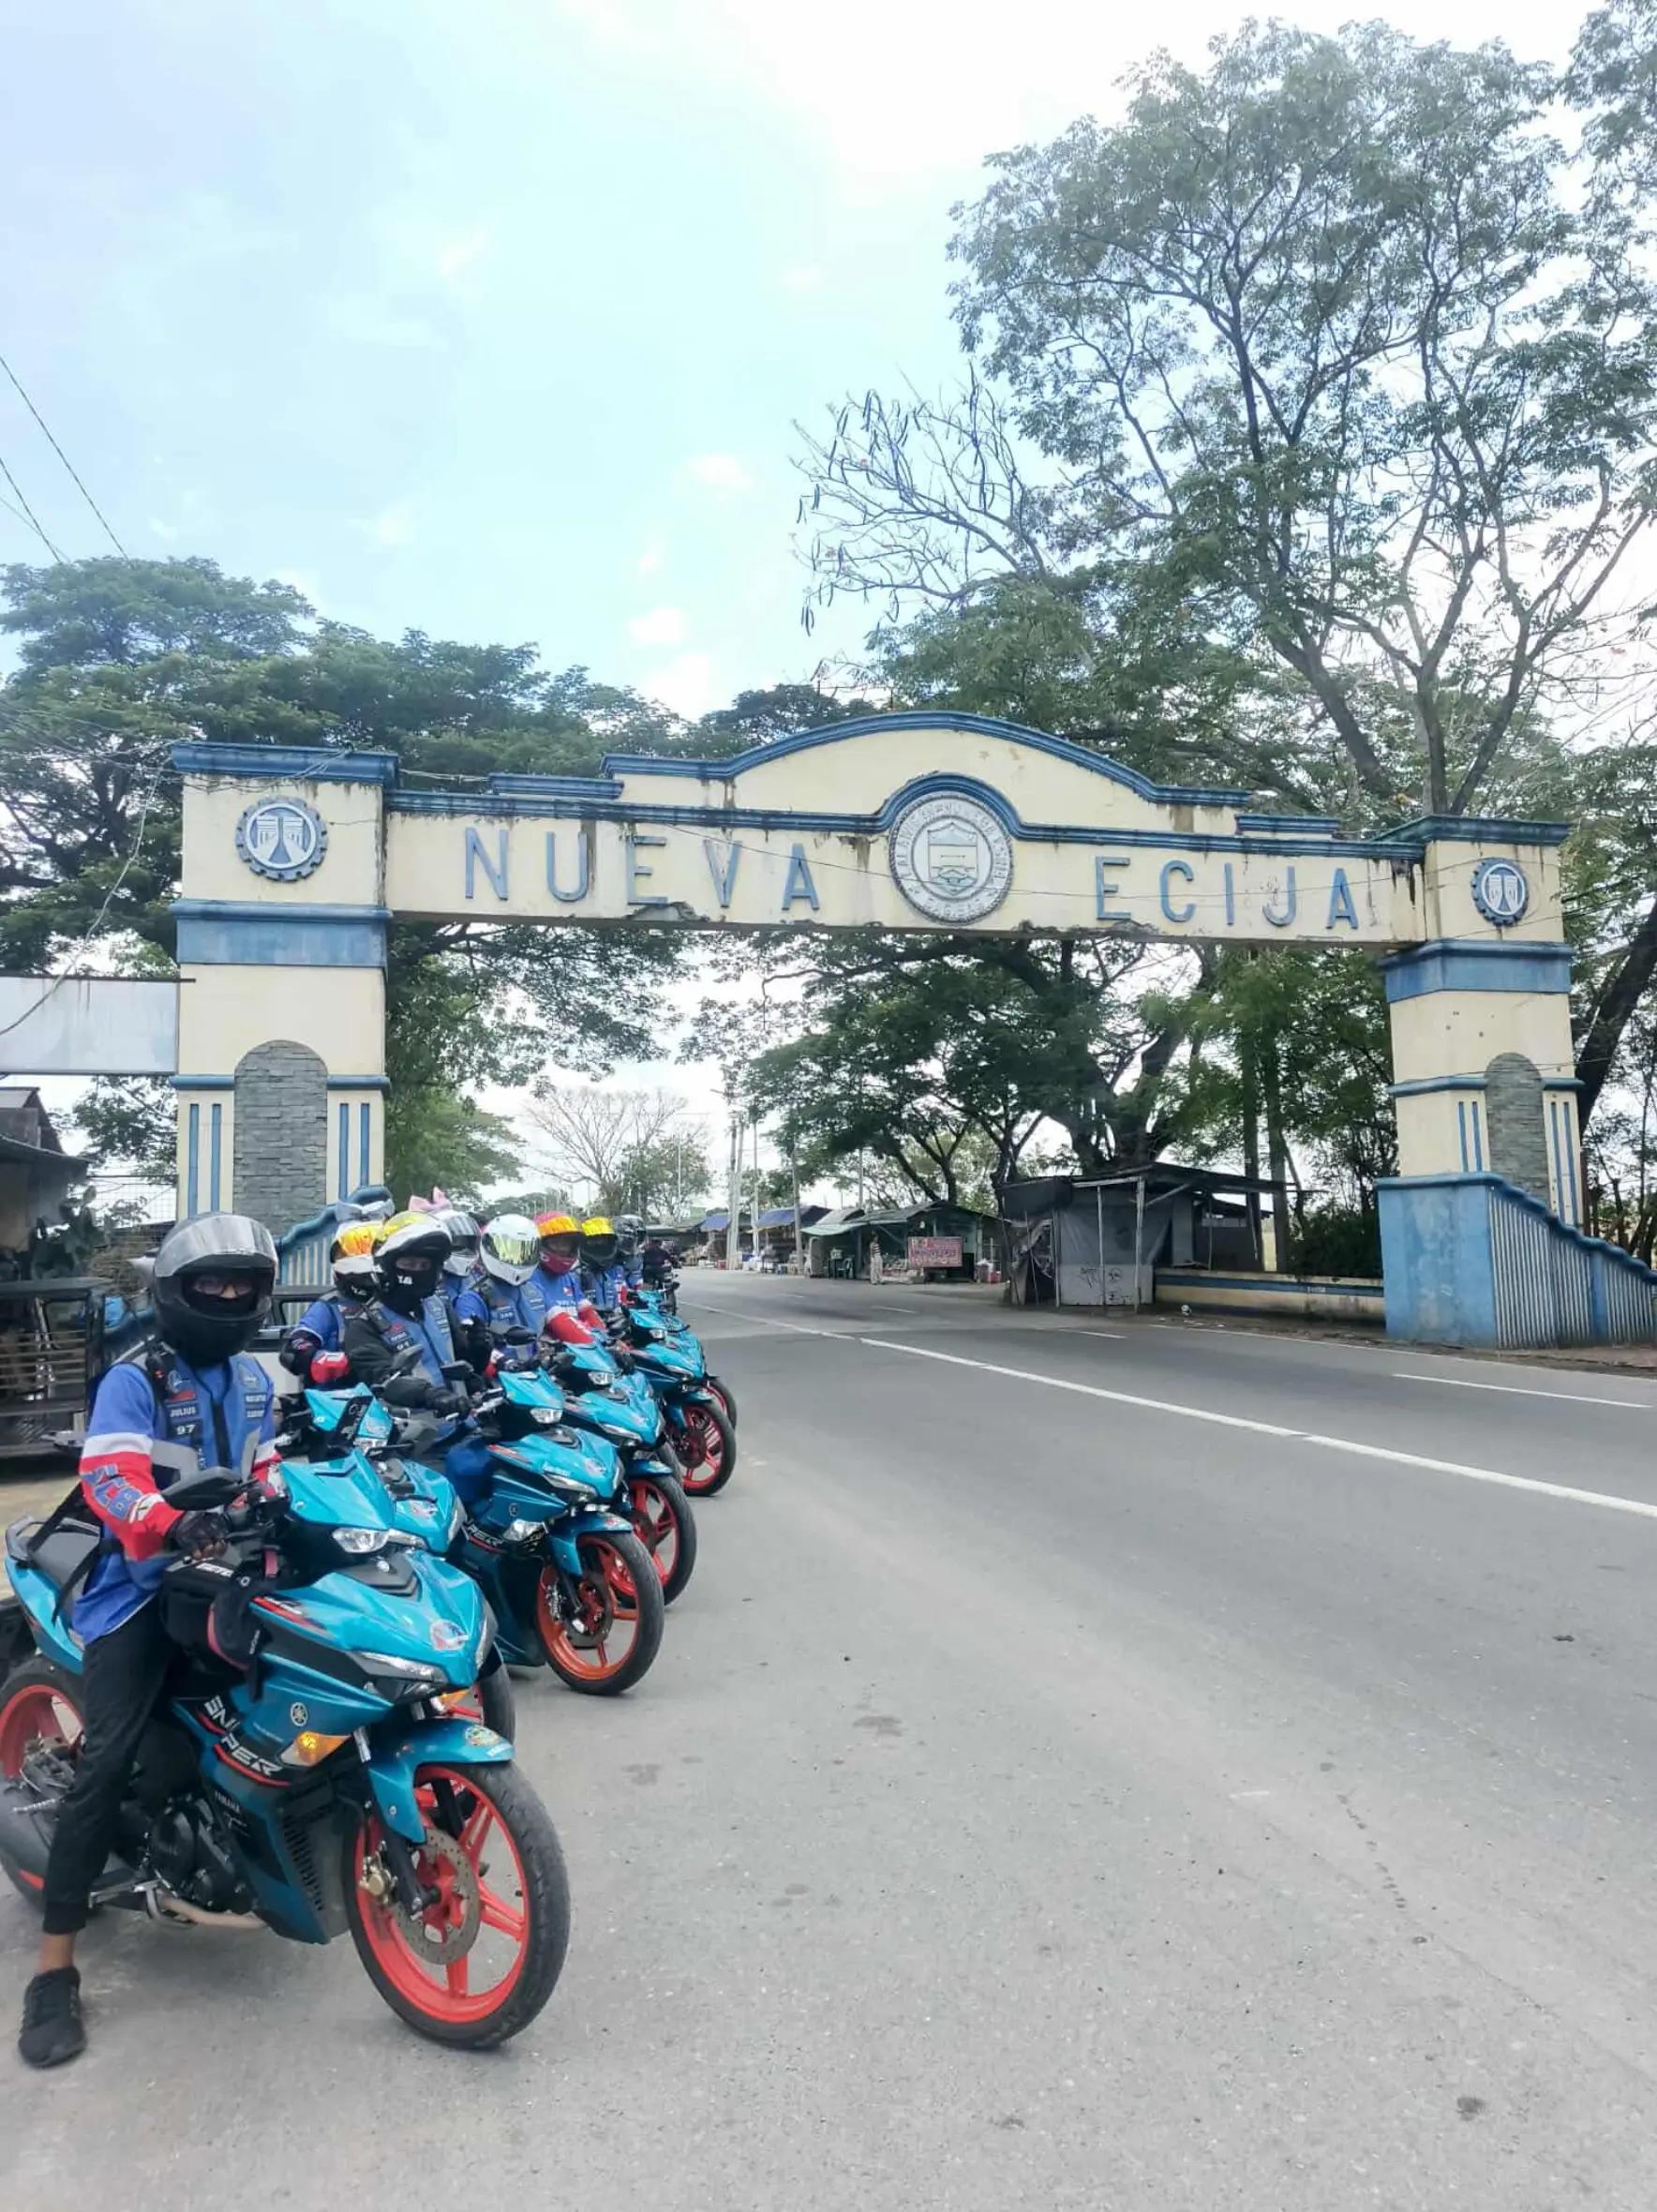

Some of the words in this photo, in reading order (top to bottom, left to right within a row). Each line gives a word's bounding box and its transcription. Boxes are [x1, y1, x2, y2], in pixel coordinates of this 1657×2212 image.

[464, 826, 820, 911] NUEVA
[1095, 855, 1359, 930] ECIJA
[170, 1406, 196, 1418] JULIUS
[176, 1424, 196, 1435] 97
[203, 1695, 283, 1776] SNIPER
